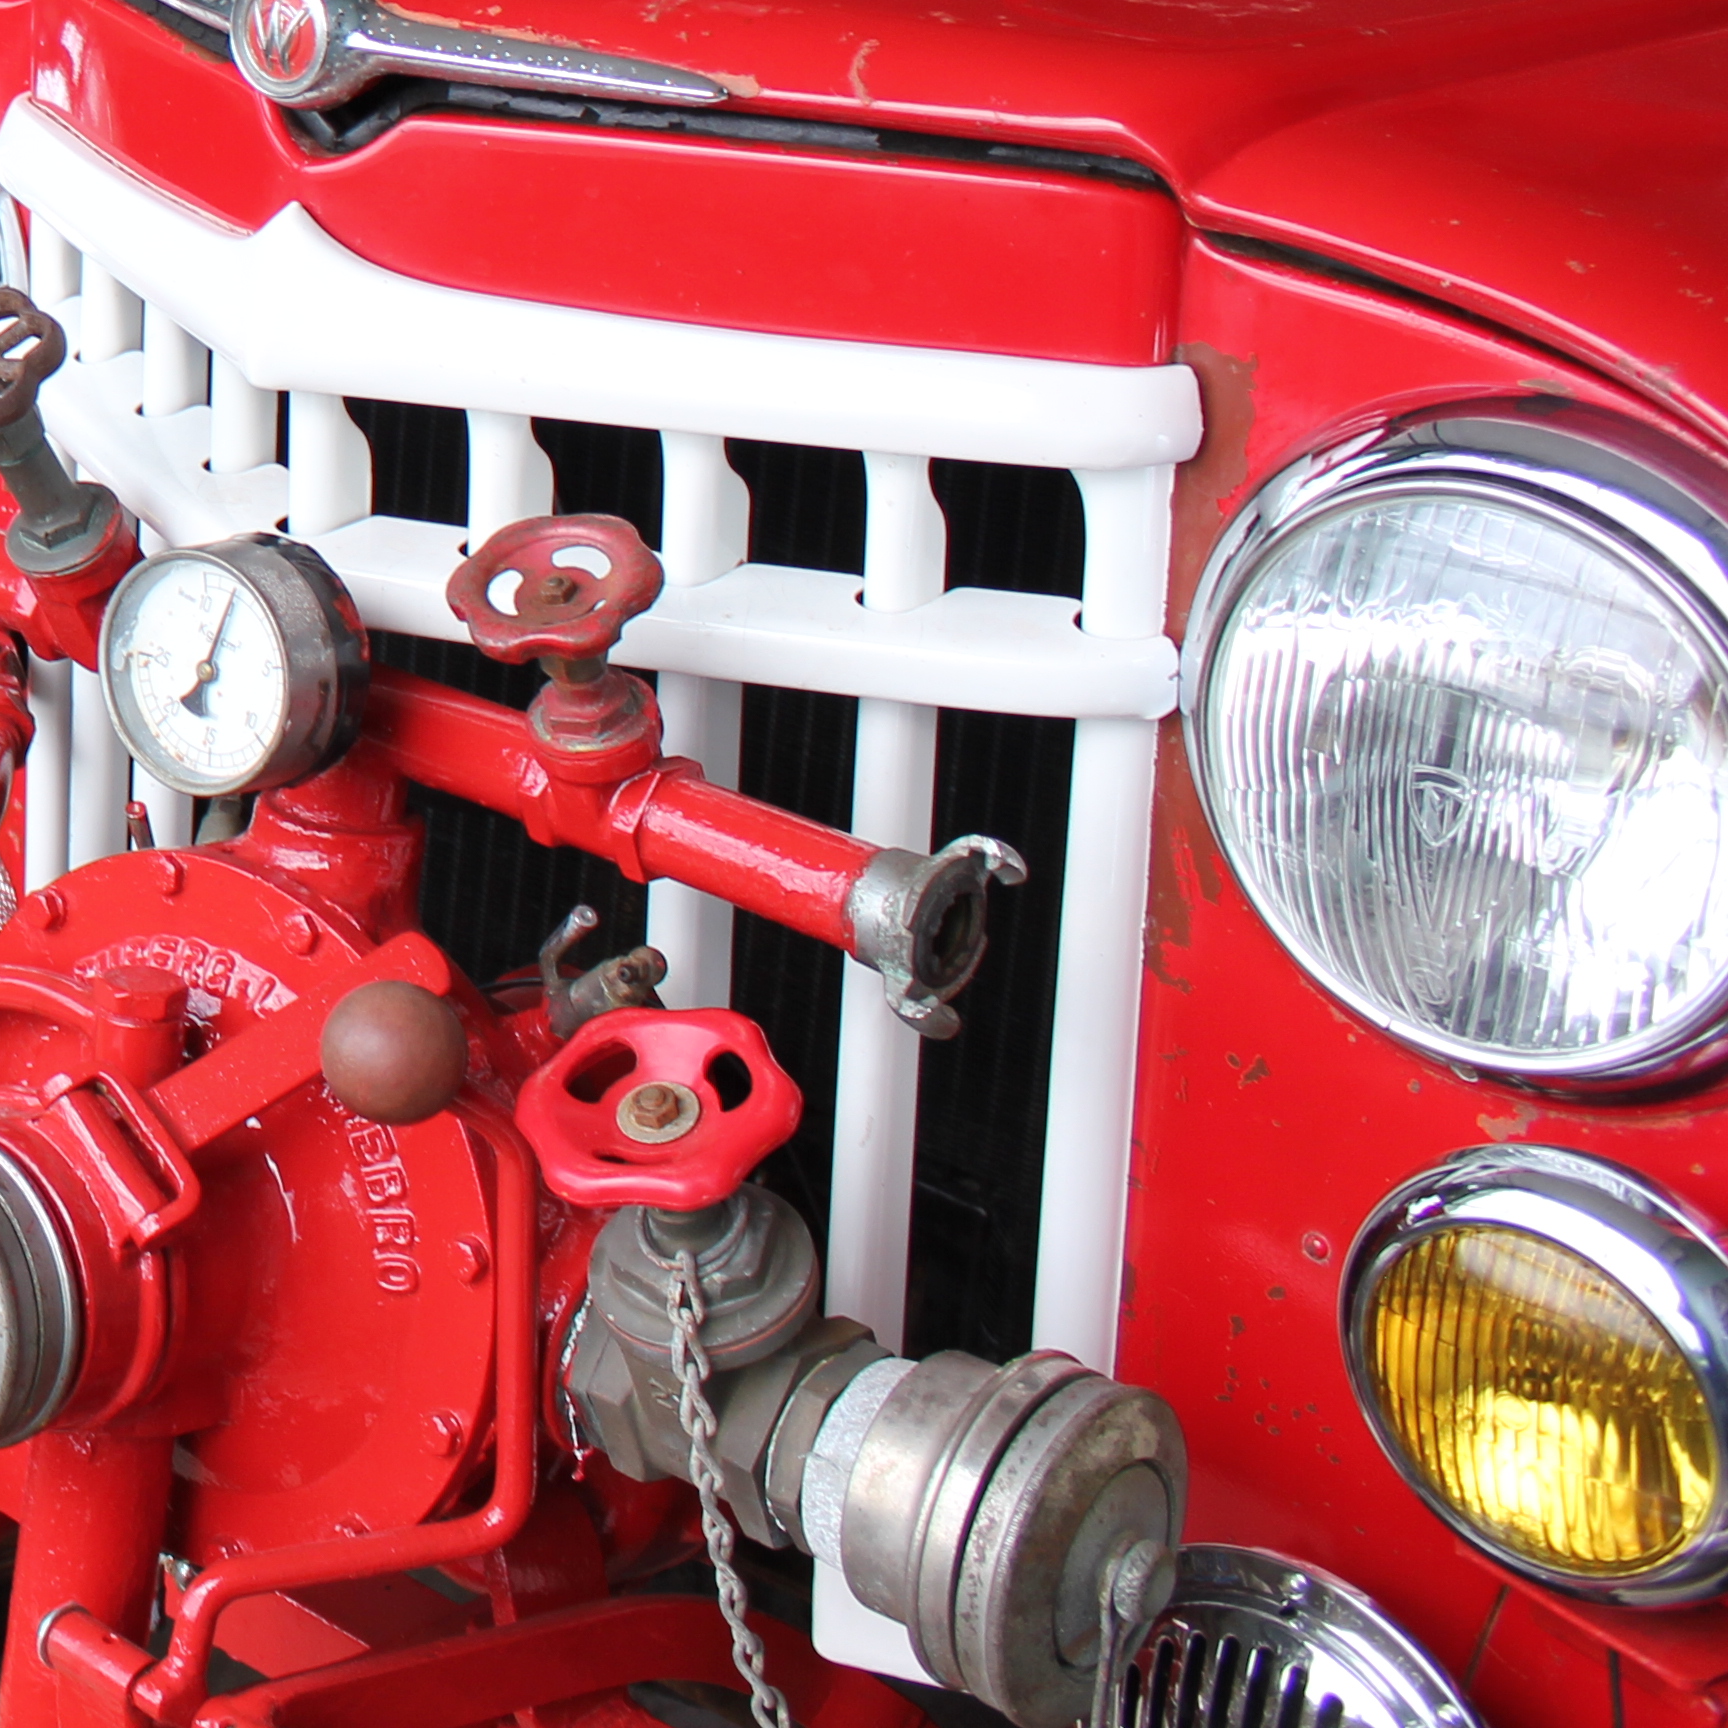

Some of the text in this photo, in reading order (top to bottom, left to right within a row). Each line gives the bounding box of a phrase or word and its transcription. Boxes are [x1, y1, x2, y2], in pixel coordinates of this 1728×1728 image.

[154, 645, 172, 669] 25
[261, 659, 273, 678] 5
[163, 695, 181, 717] 20
[244, 710, 258, 730] 10
[201, 725, 217, 746] 15
[329, 1096, 423, 1295] EBRO
